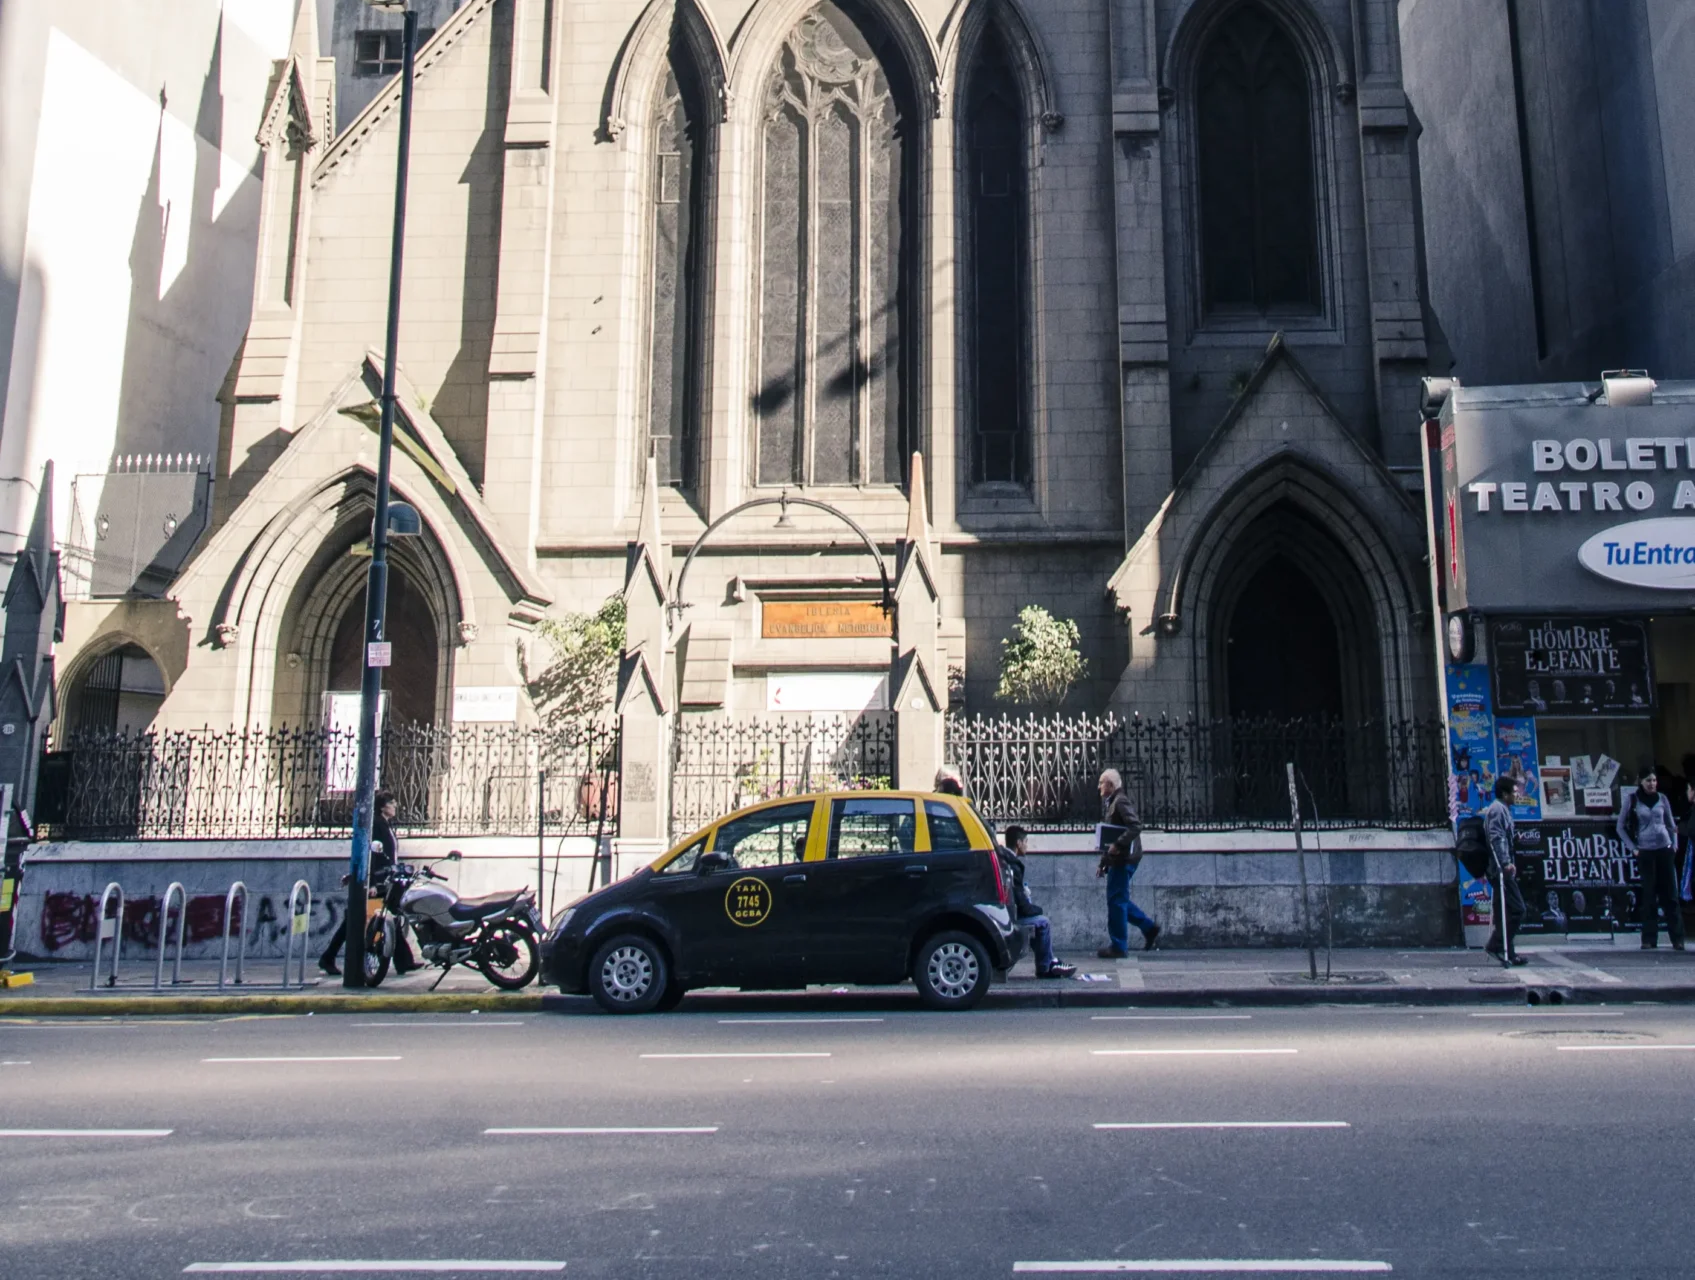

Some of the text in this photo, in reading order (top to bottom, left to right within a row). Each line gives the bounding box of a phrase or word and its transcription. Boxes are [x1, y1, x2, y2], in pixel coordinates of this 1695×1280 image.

[1468, 482, 1655, 511] TEATRO
[1543, 620, 1556, 632] EL
[1528, 625, 1612, 650] HOMBRE
[1562, 827, 1575, 840] EL
[1543, 858, 1641, 884] ELEFANTE
[737, 895, 759, 908] 7745
